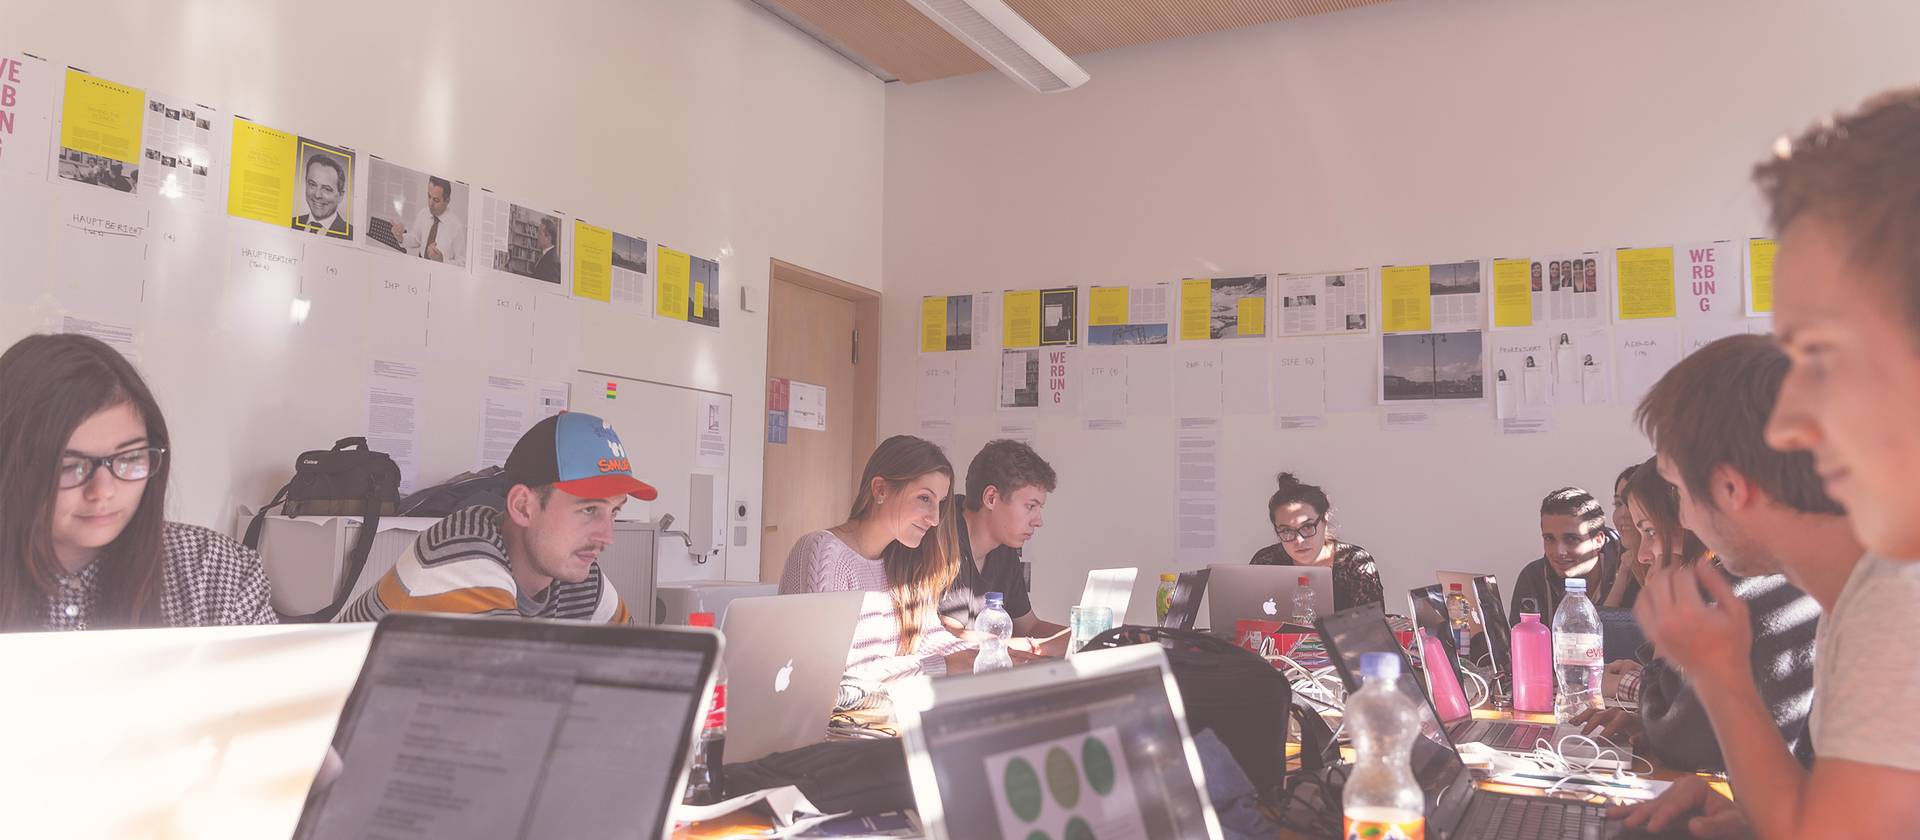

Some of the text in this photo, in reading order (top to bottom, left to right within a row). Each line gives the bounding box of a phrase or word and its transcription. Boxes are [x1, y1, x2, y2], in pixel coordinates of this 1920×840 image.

[1689, 248, 1715, 263] WE
[1692, 265, 1715, 279] RB
[1692, 281, 1715, 296] UN
[1699, 297, 1711, 312] G
[1050, 352, 1066, 364] WE
[1050, 365, 1065, 377] RB
[1050, 379, 1065, 390] UN
[1054, 391, 1061, 404] G
